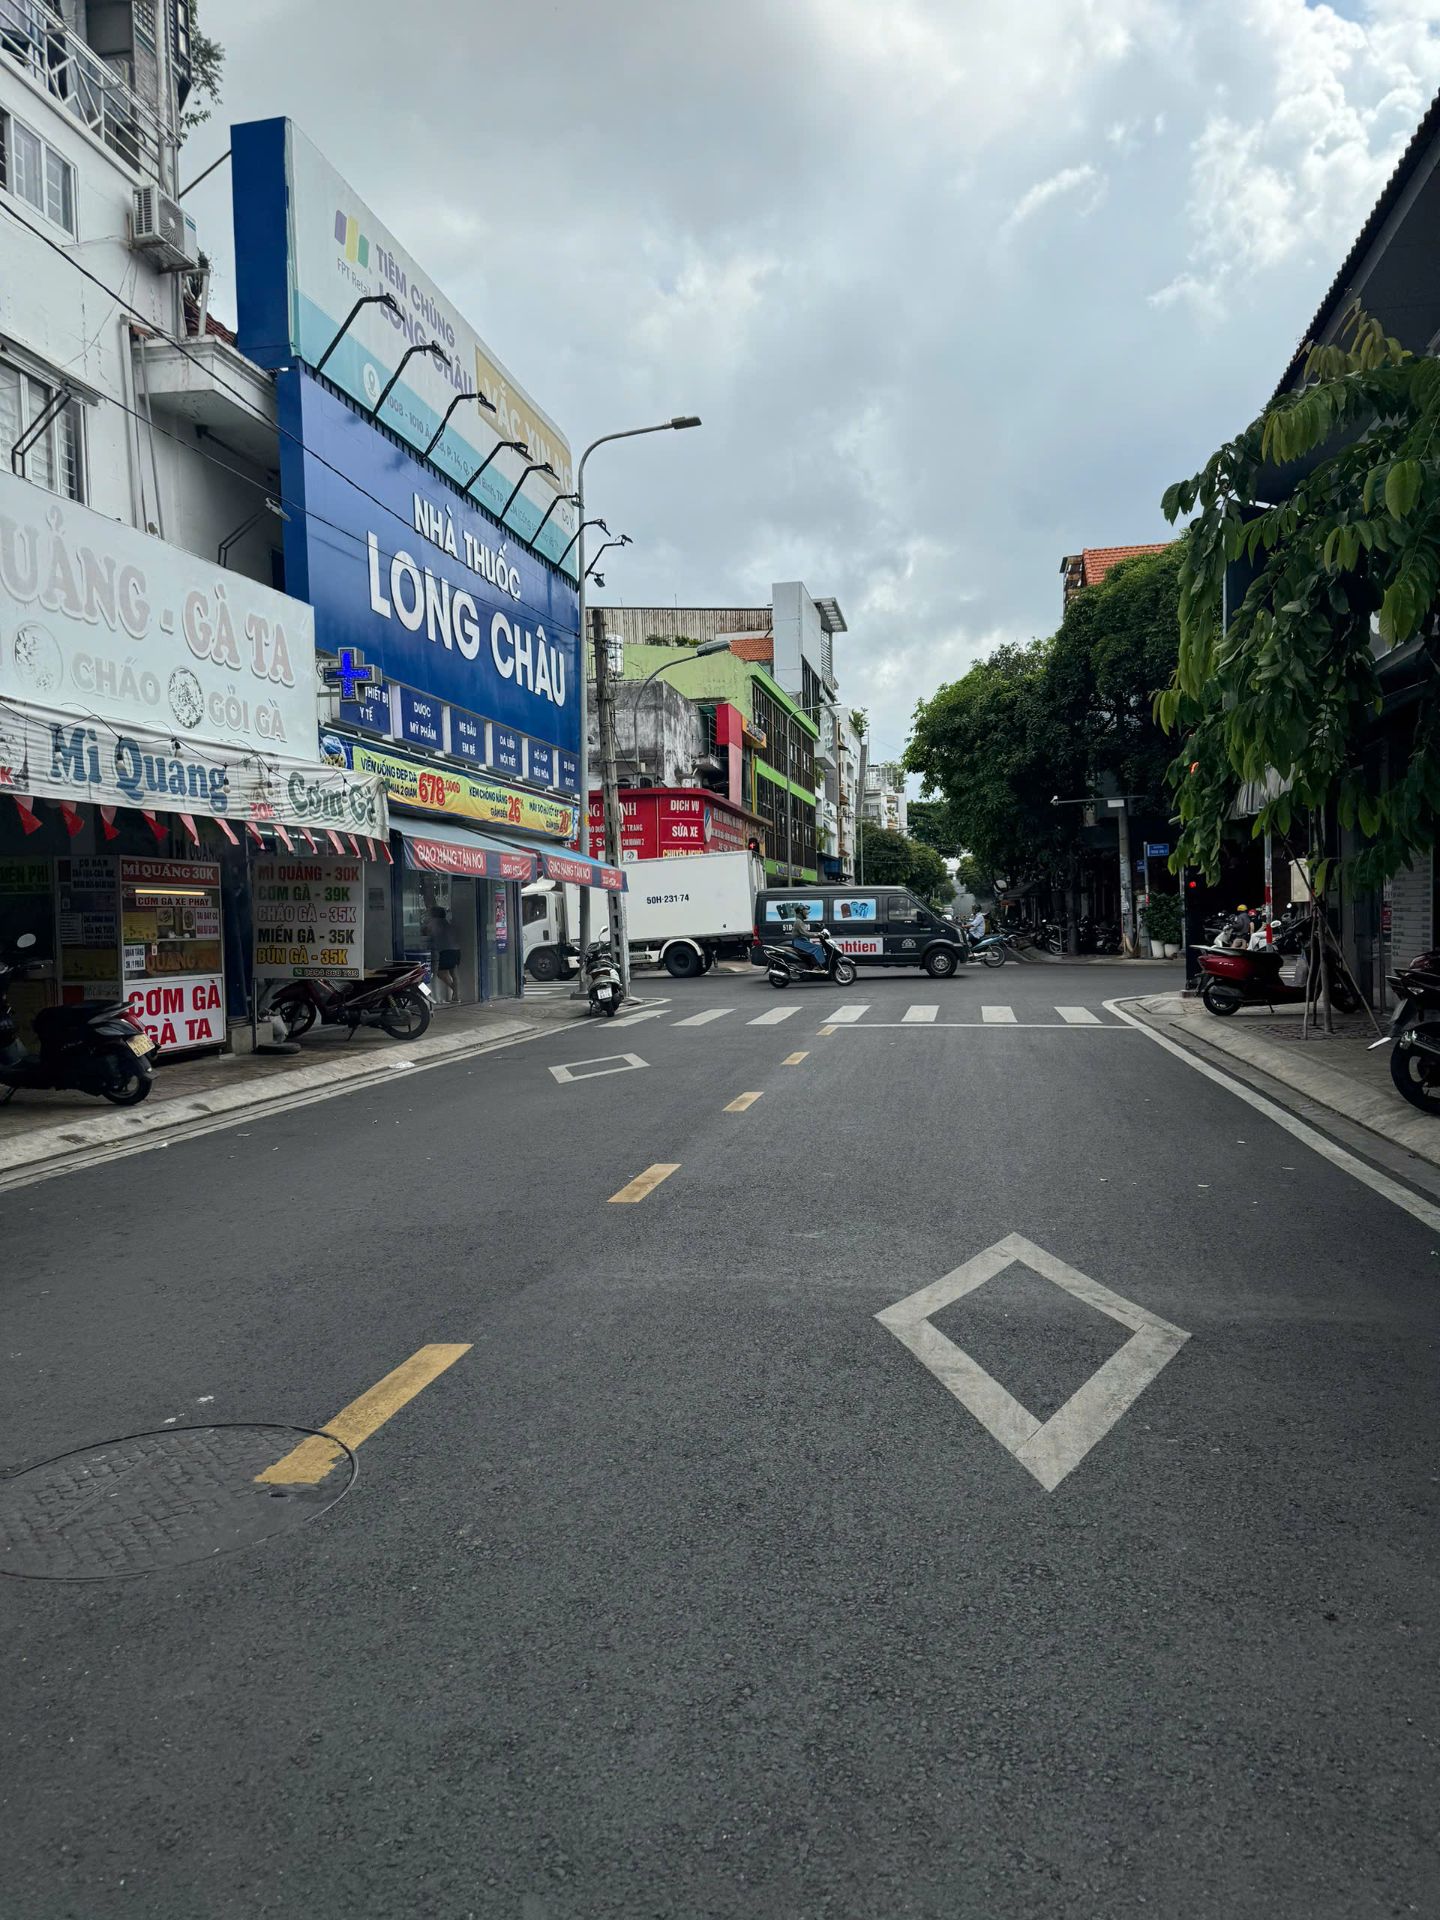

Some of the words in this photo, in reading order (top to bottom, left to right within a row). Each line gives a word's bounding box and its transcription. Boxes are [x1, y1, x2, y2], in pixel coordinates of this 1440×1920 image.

[337, 258, 350, 280] FPT
[376, 243, 407, 300] TIÊM
[379, 281, 427, 346] LONG
[413, 492, 459, 559] NHÀ
[463, 530, 521, 601] THUỐC
[367, 530, 481, 661] LONG
[490, 612, 566, 708] CHÂU
[183, 583, 243, 670] GÀ
[245, 613, 296, 688] TA
[71, 653, 161, 706] CHÁO
[255, 696, 288, 744] GÀ
[365, 706, 374, 721] TẾ
[413, 701, 432, 718] DƯỢC
[49, 723, 102, 784] Mì
[376, 758, 396, 778] UỐNG
[670, 799, 690, 813] DỊCH
[691, 800, 699, 814] VỤ
[672, 822, 688, 837] SỬA
[690, 826, 698, 837] XE
[416, 844, 437, 864] GIAO
[437, 844, 458, 867] HÀNG
[458, 847, 471, 871] TẬN
[122, 861, 140, 875] MÌ
[192, 868, 214, 880] 30K
[257, 862, 273, 880] MÌ
[279, 861, 322, 882] QUẢNG
[335, 866, 359, 881] 30K
[137, 896, 158, 905] CƠM
[259, 885, 288, 901] CƠM
[293, 883, 311, 901] GÀ
[324, 887, 350, 902] 39K
[257, 903, 295, 923] CHÁO
[297, 903, 317, 923] GÀ
[328, 907, 357, 923] 35K
[297, 926, 316, 944] GÀ
[329, 929, 354, 944] 35K
[256, 945, 286, 965] BÚN
[289, 945, 309, 965] GÀ
[320, 949, 349, 965] 35K
[128, 986, 184, 1019] CƠM
[192, 980, 221, 1011] GÀ
[144, 1018, 177, 1045] GÀ
[185, 1018, 212, 1041] TA
